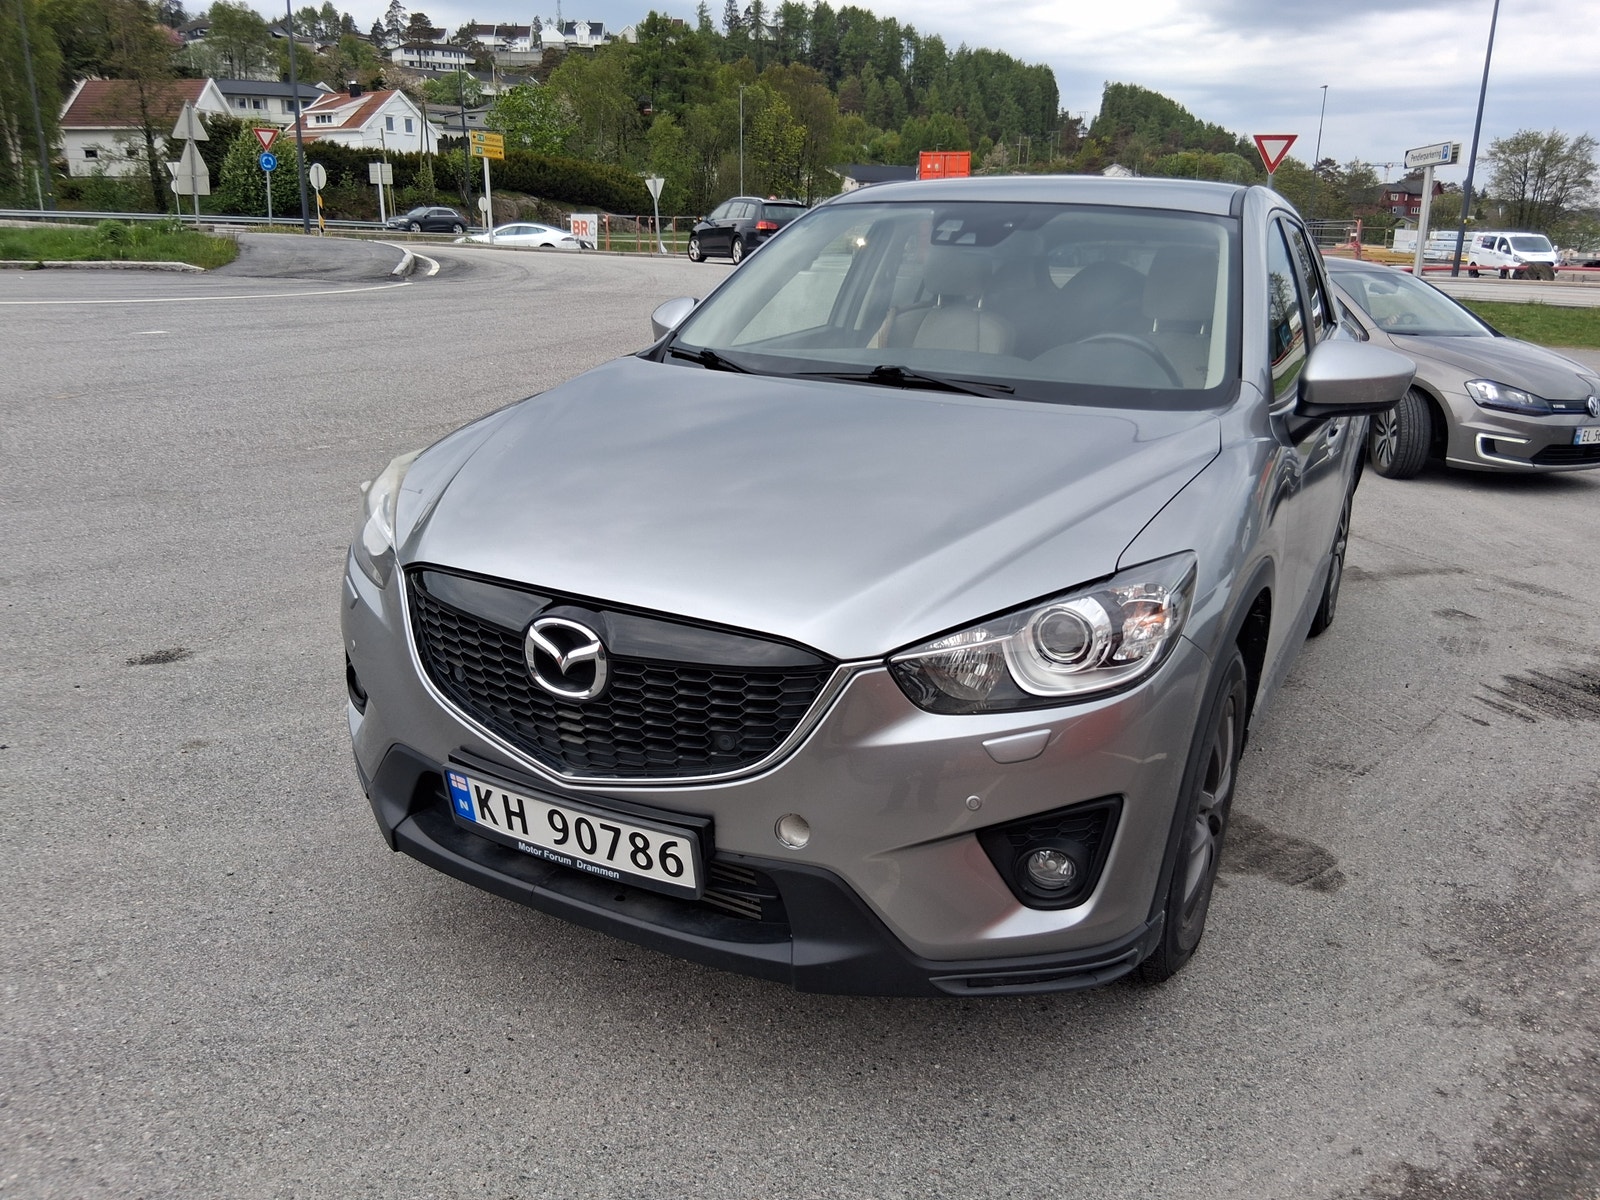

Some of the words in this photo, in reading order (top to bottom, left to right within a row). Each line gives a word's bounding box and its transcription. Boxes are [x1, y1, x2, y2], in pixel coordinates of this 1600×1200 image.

[572, 220, 596, 236] BRG
[1582, 430, 1591, 441] EL
[474, 785, 529, 836] KH
[547, 809, 684, 878] 90786
[518, 841, 542, 857] Motor
[543, 849, 572, 866] Forum
[576, 859, 620, 879] Drammen
